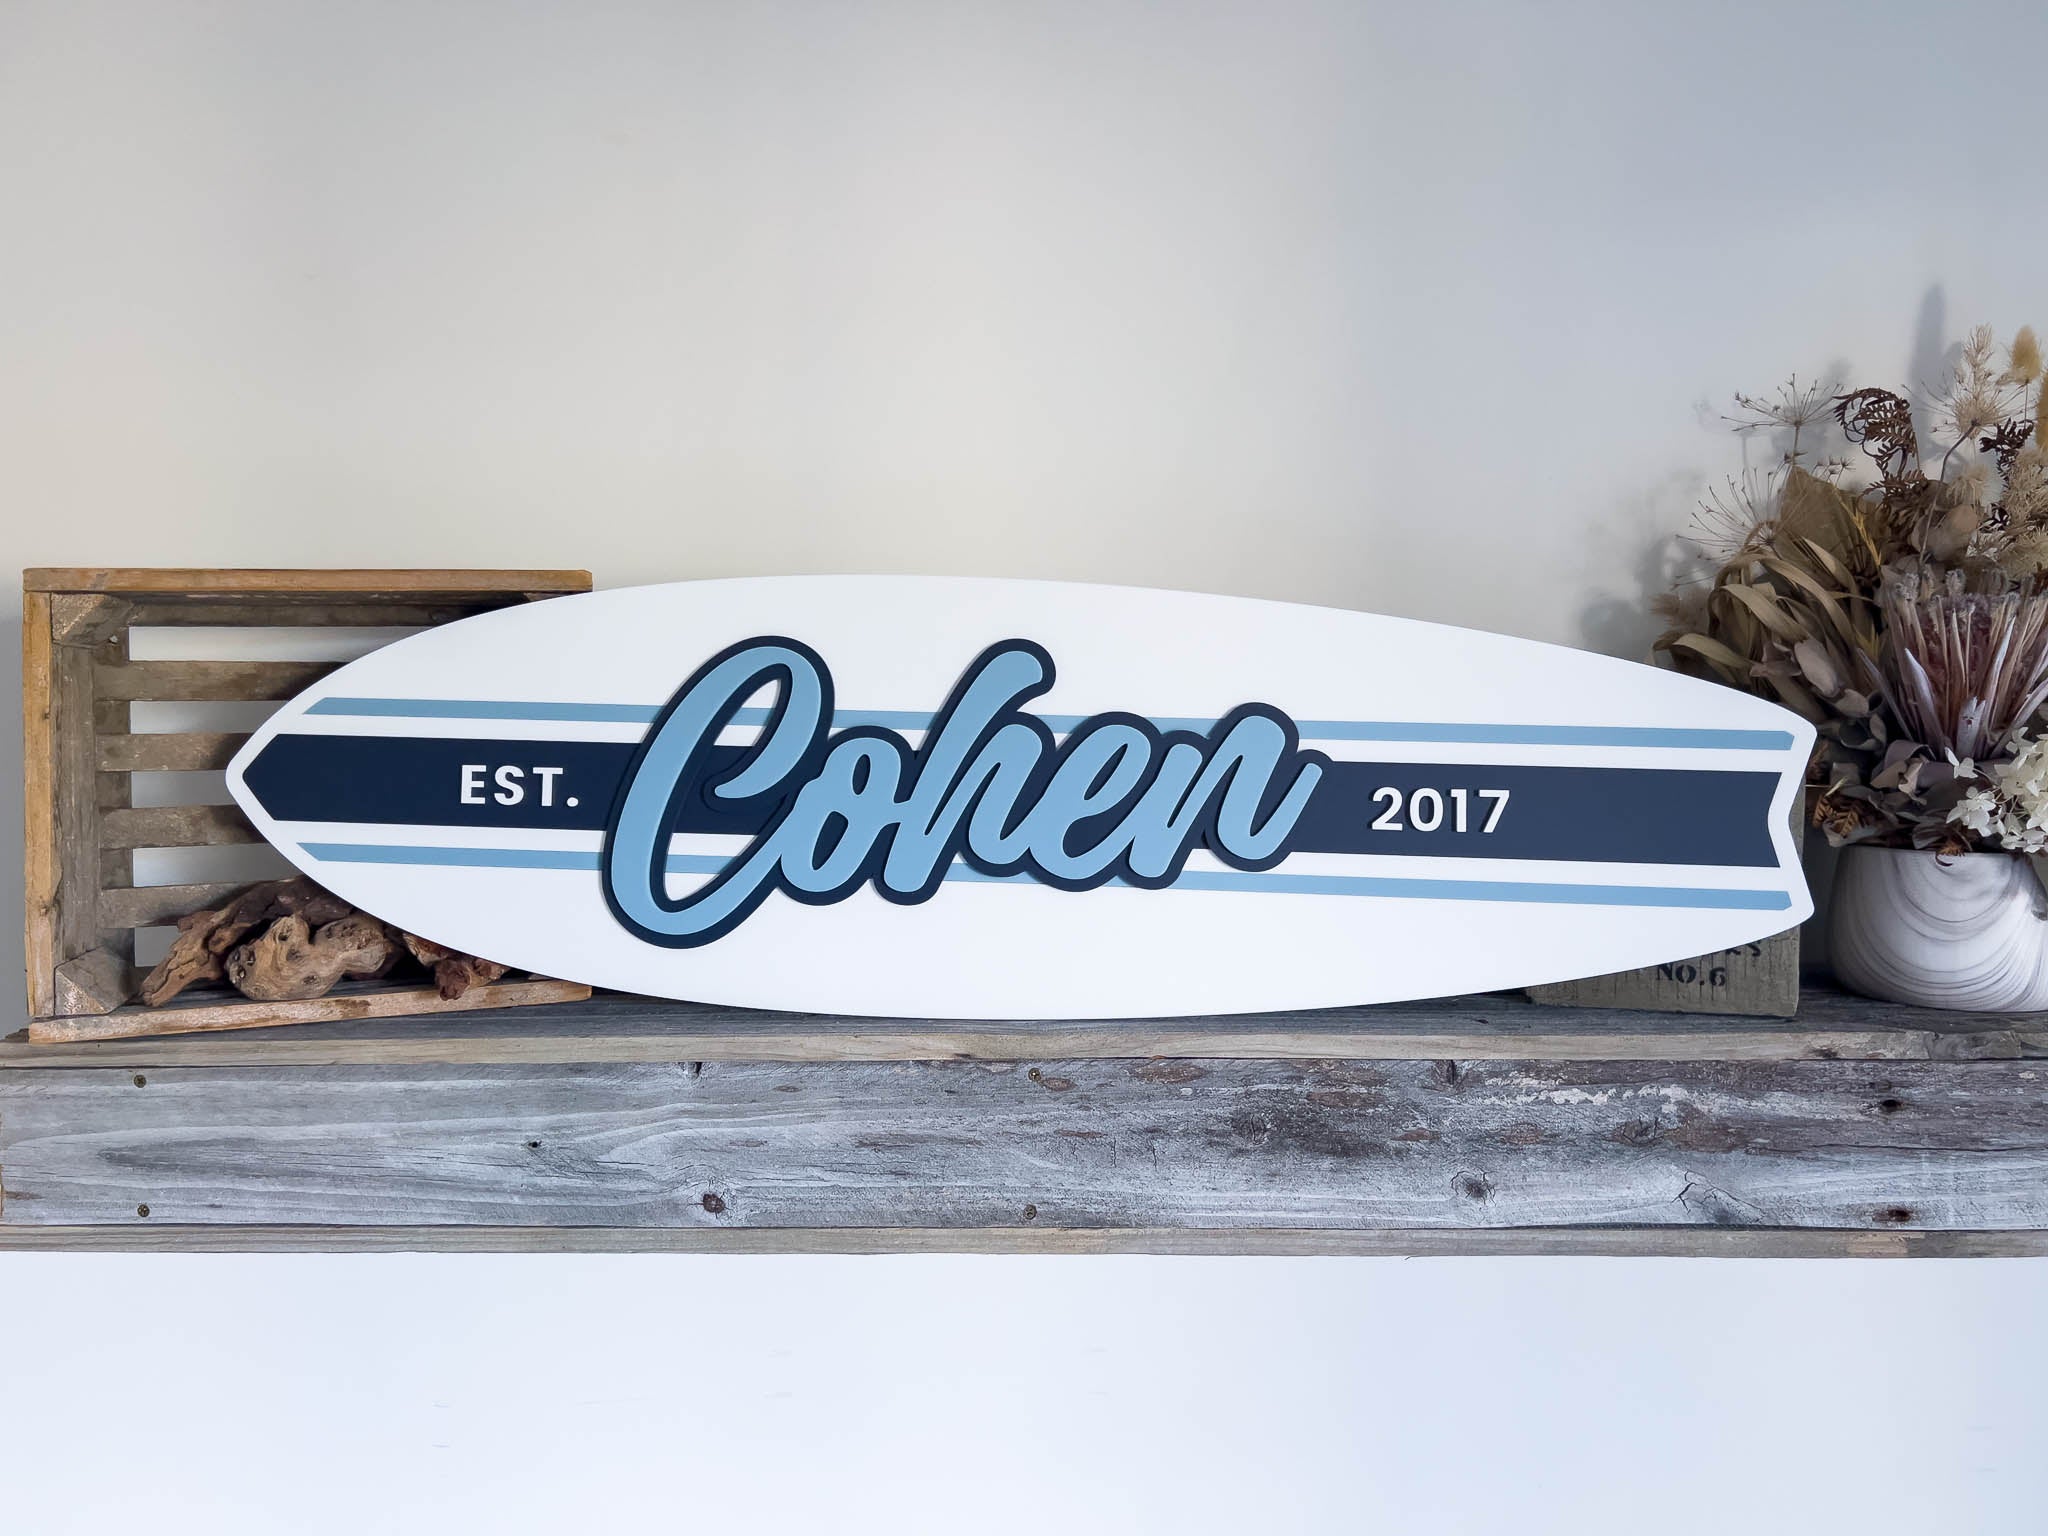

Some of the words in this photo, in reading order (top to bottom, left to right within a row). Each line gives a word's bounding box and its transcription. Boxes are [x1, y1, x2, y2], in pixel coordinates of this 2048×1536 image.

[460, 764, 579, 808] EST.
[601, 635, 1333, 949] Cohen
[1371, 786, 1511, 833] 2017
